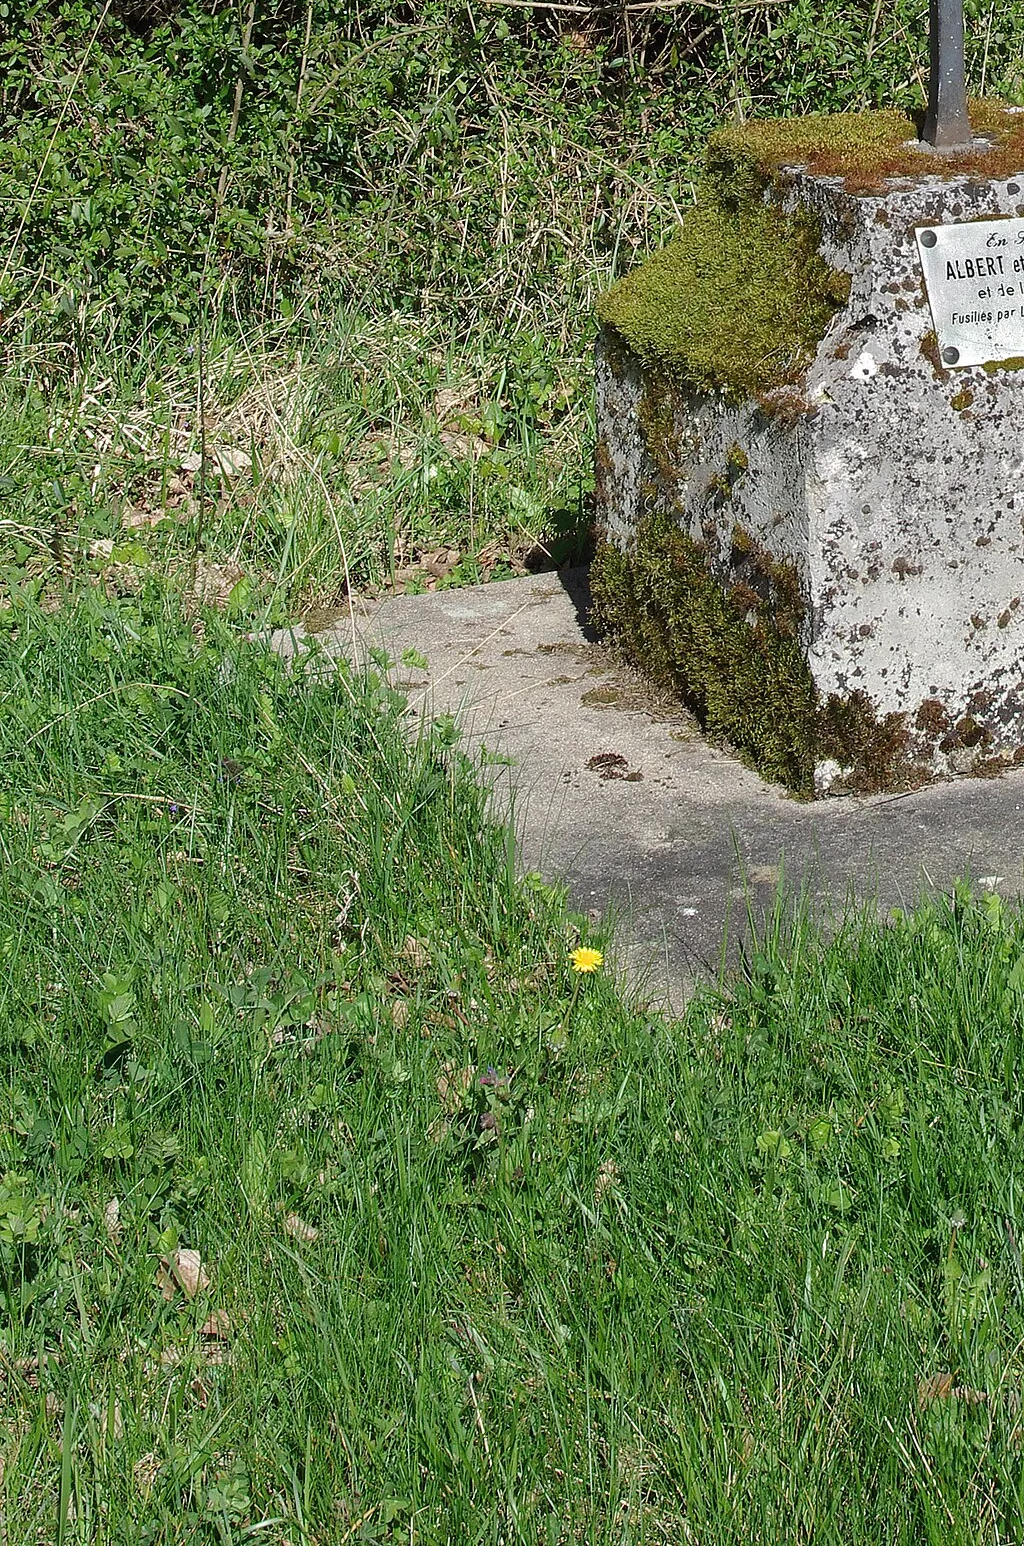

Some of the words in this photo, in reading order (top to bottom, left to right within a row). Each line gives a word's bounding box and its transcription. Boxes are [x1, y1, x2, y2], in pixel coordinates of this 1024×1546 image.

[986, 232, 1008, 247] En
[946, 255, 1004, 280] ALBERT
[978, 286, 992, 299] et
[998, 283, 1015, 296] de
[997, 309, 1016, 322] par
